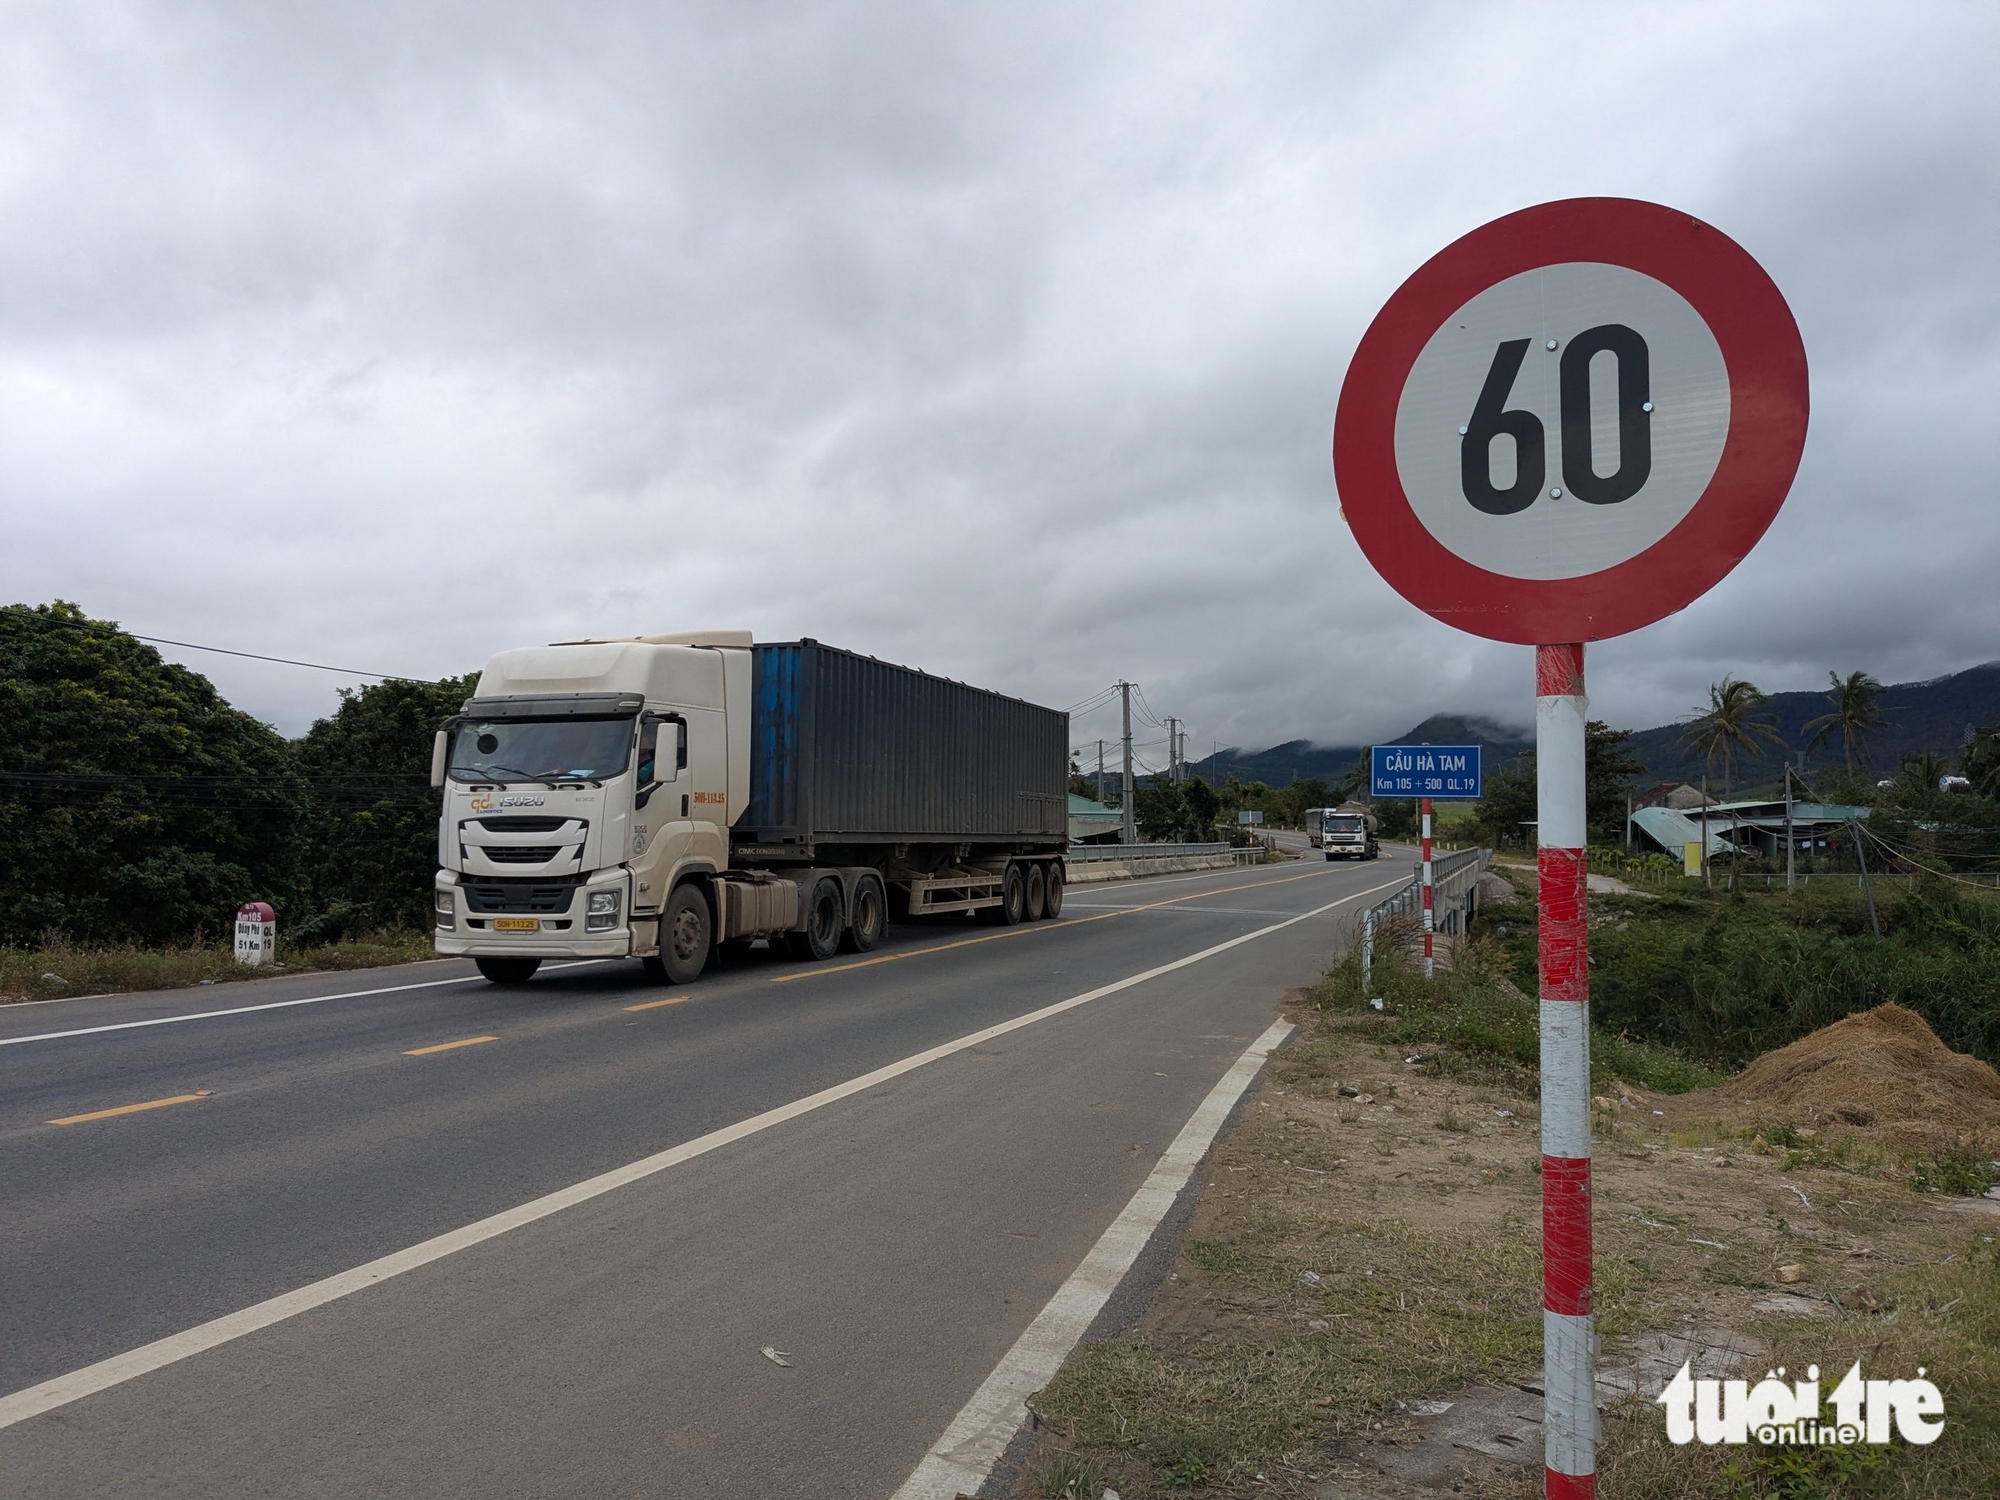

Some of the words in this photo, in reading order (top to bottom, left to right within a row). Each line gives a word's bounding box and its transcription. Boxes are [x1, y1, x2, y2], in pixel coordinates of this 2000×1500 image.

[1461, 323, 1651, 515] 60
[1386, 749, 1412, 771] CẦU
[1417, 751, 1435, 771] HÀ
[1377, 778, 1393, 789] Km
[1396, 778, 1412, 790] 105
[1425, 778, 1442, 790] 500
[500, 796, 545, 807] ISUZU
[263, 926, 273, 937] QL
[264, 938, 272, 949] 19
